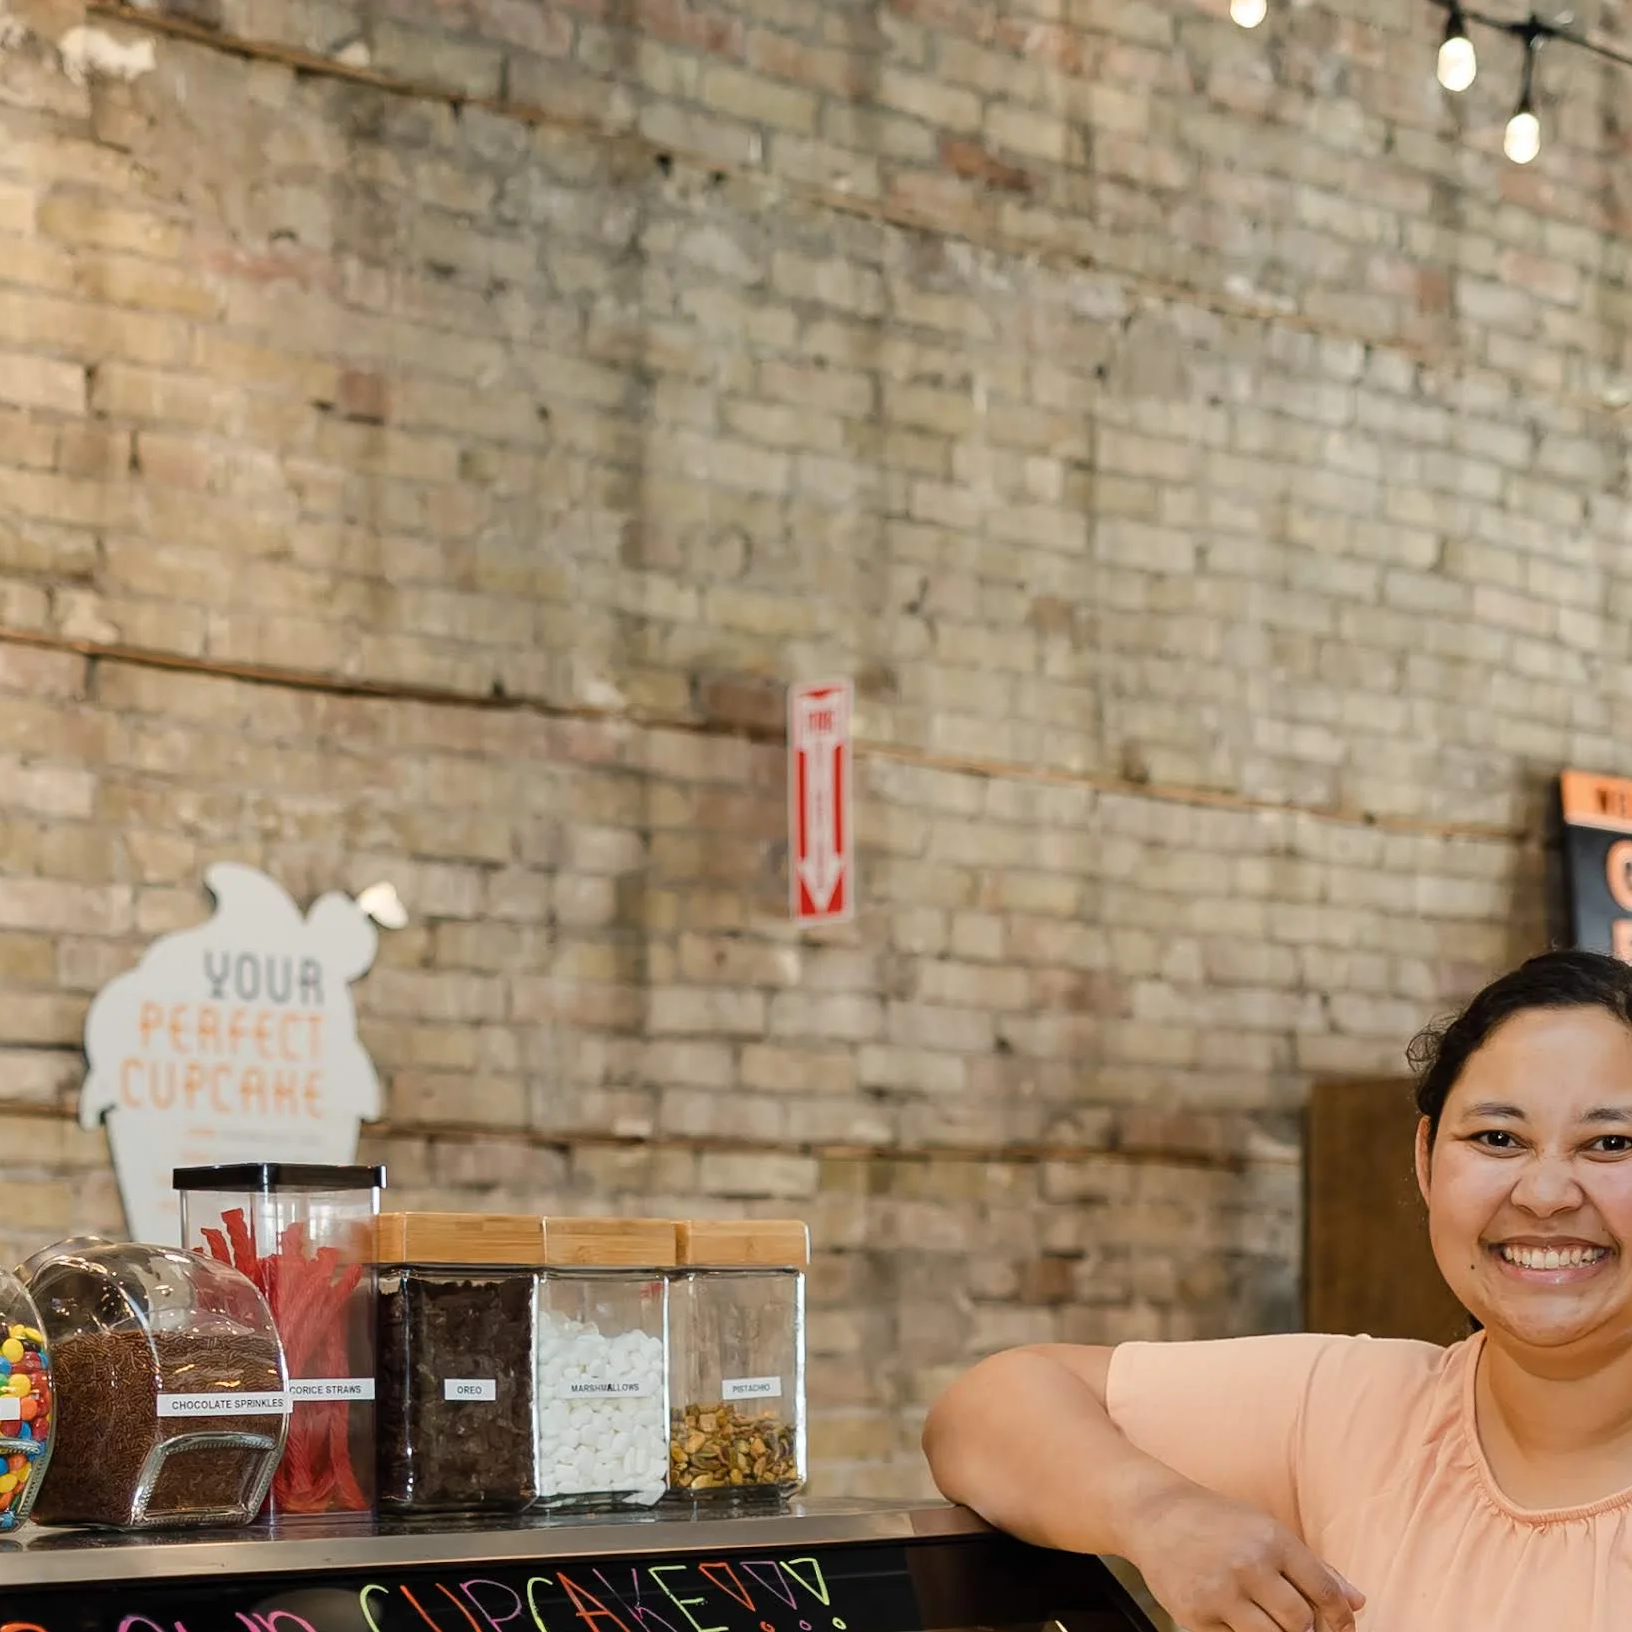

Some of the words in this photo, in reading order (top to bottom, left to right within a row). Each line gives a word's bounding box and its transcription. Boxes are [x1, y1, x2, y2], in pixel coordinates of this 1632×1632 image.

[202, 950, 325, 1006] YOUR
[138, 1002, 325, 1062] PERFECT
[119, 1057, 324, 1119] CUPCAKE
[325, 1384, 362, 1396] STRAWS
[456, 1385, 483, 1395] OREO
[570, 1383, 640, 1393] MARSHMALLOWS
[732, 1383, 771, 1393] PISTACHIO
[171, 1399, 232, 1411] CHOCOLATE
[234, 1398, 284, 1409] SPRINKLES
